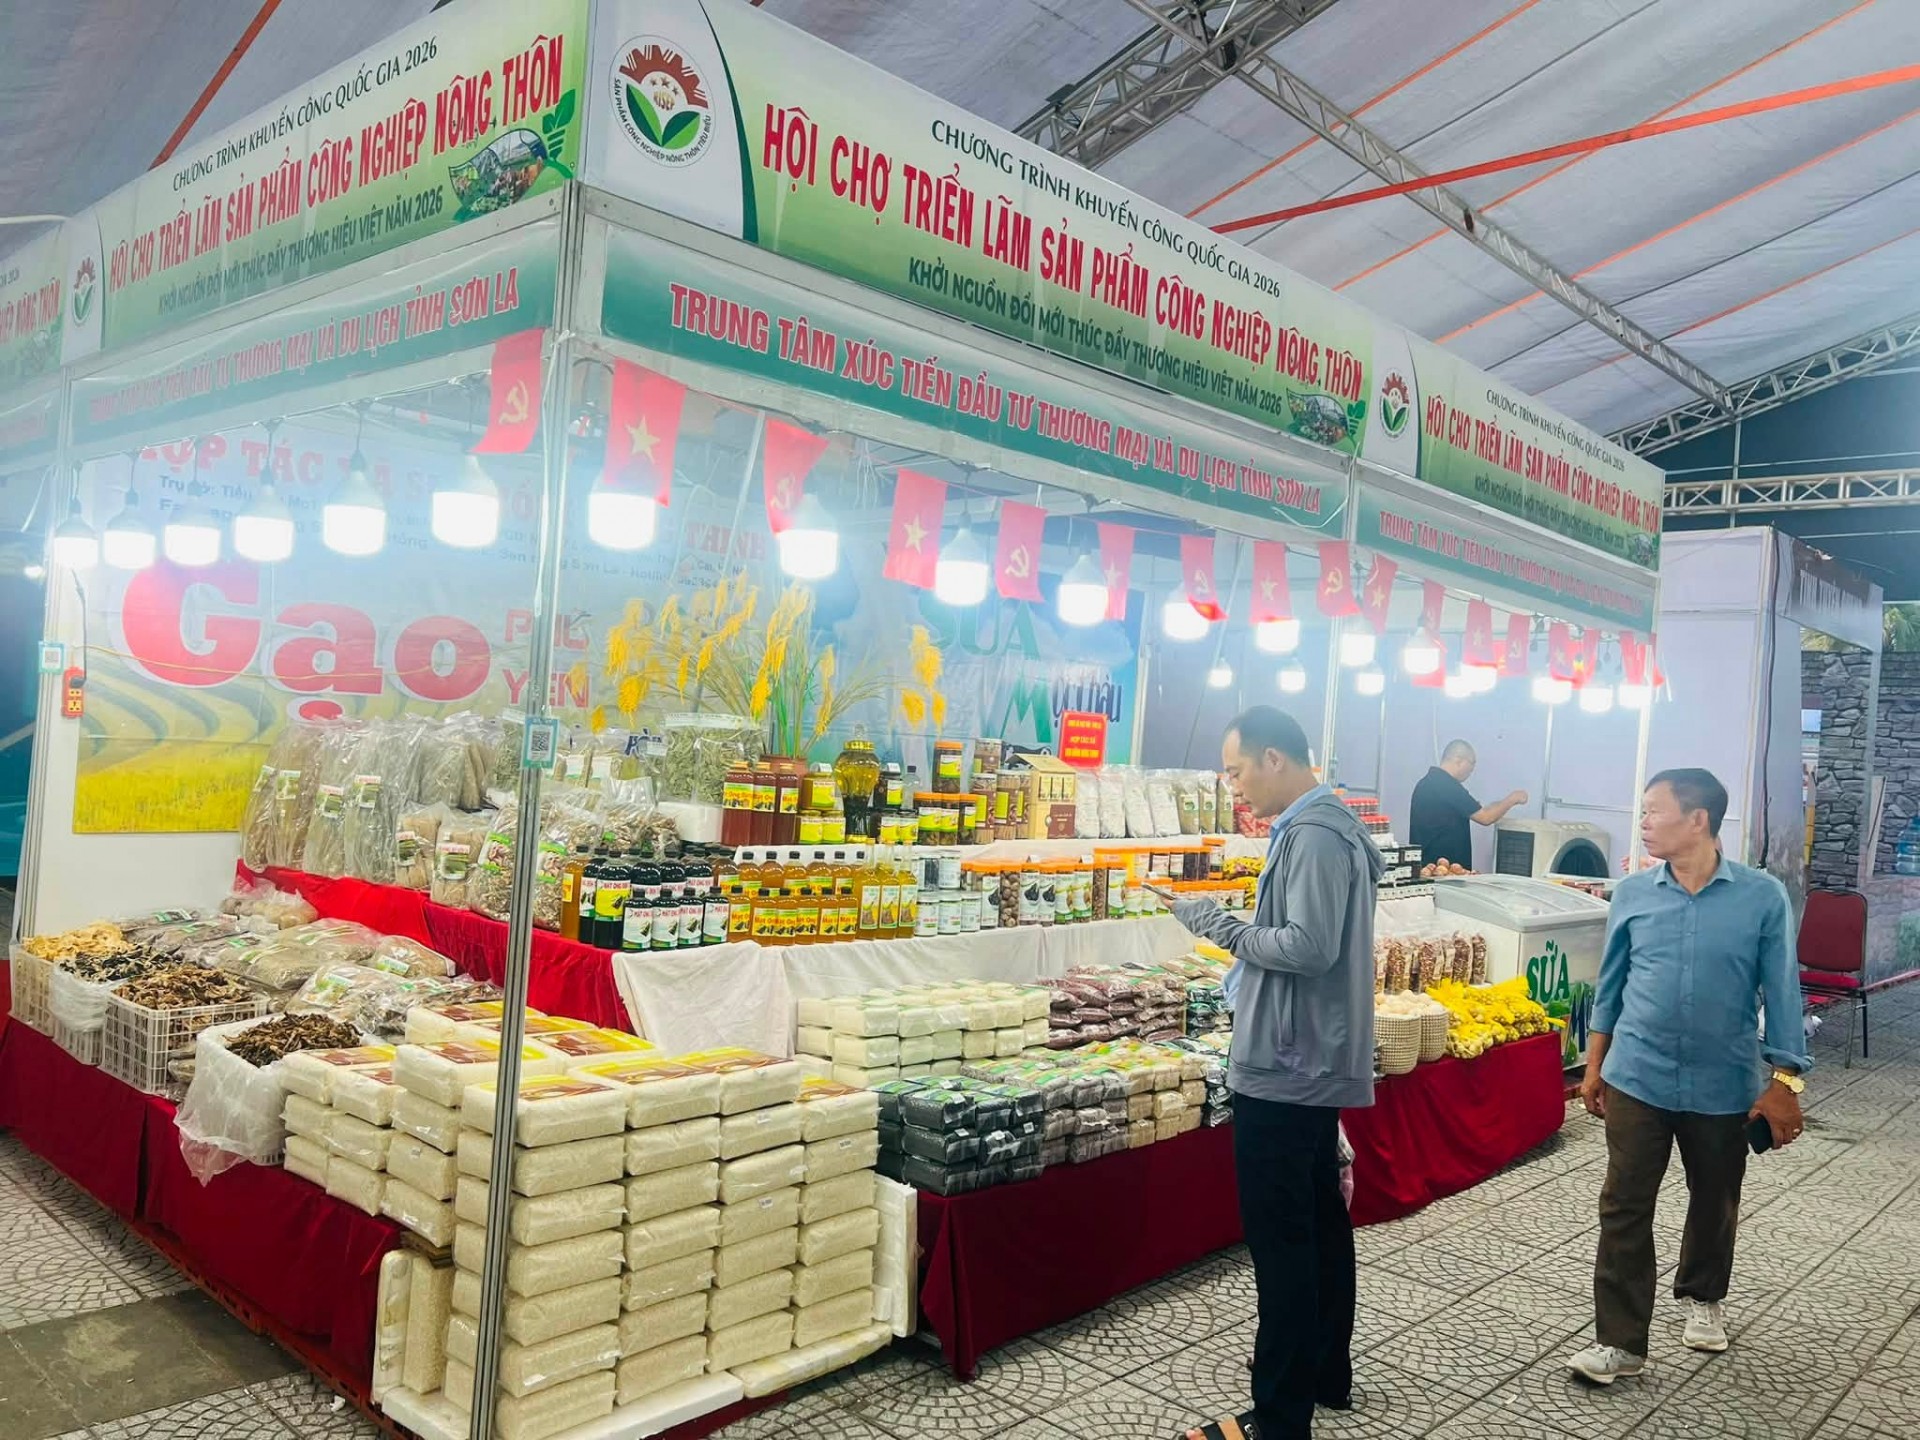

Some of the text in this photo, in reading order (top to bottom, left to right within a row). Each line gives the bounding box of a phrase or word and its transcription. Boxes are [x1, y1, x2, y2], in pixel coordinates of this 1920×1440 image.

[159, 198, 192, 271] TRIỂN
[195, 194, 222, 257] LÃM
[226, 172, 254, 243] SẢN
[258, 146, 302, 229] PHẨM
[307, 136, 353, 209] CÔNG
[359, 97, 427, 182] NGHIỆP
[433, 74, 492, 156] NÔNG
[503, 34, 564, 127] THÔN
[173, 36, 438, 191] CHƯƠNG TRÌNH KHUYẾN CÔNG QUỐC GIA 2026
[332, 215, 356, 255] HIỆU
[359, 204, 384, 246] VIỆT
[386, 194, 413, 229] NĂM
[414, 185, 443, 222] 2026
[763, 103, 1363, 401] HỘI CHỢ TRIỂN LÃM SẢN PHẨM CÔNG NGHIỆP NÔNG THÔN
[932, 119, 1280, 298] CHƯƠNG TRÌNH KHUYẾN CÔNG QUỐC GIA 2026
[338, 316, 360, 357] DU
[364, 303, 401, 357] LỊCH
[405, 284, 446, 339] TỈNH
[449, 275, 490, 327] SƠN
[494, 267, 519, 315] LA
[909, 256, 1283, 416] KHỞI NGUỒN ĐỔI MỚI THÚC ĐẨY THƯƠNG HIỆU VIỆT NĂM 2026
[669, 282, 1322, 515] TRUNG TÂM XÚC TIẾN ĐẦU TƯ THƯƠNG MẠI VÀ DU LỊCH TỈNH SƠN LA
[1474, 414, 1502, 466] TRIỂN
[1571, 465, 1593, 505] CÔNG
[1380, 511, 1414, 545] TRUNG
[1417, 521, 1439, 553] TÂM
[121, 555, 493, 722] Gạo
[1526, 940, 1570, 1004] SỮA
